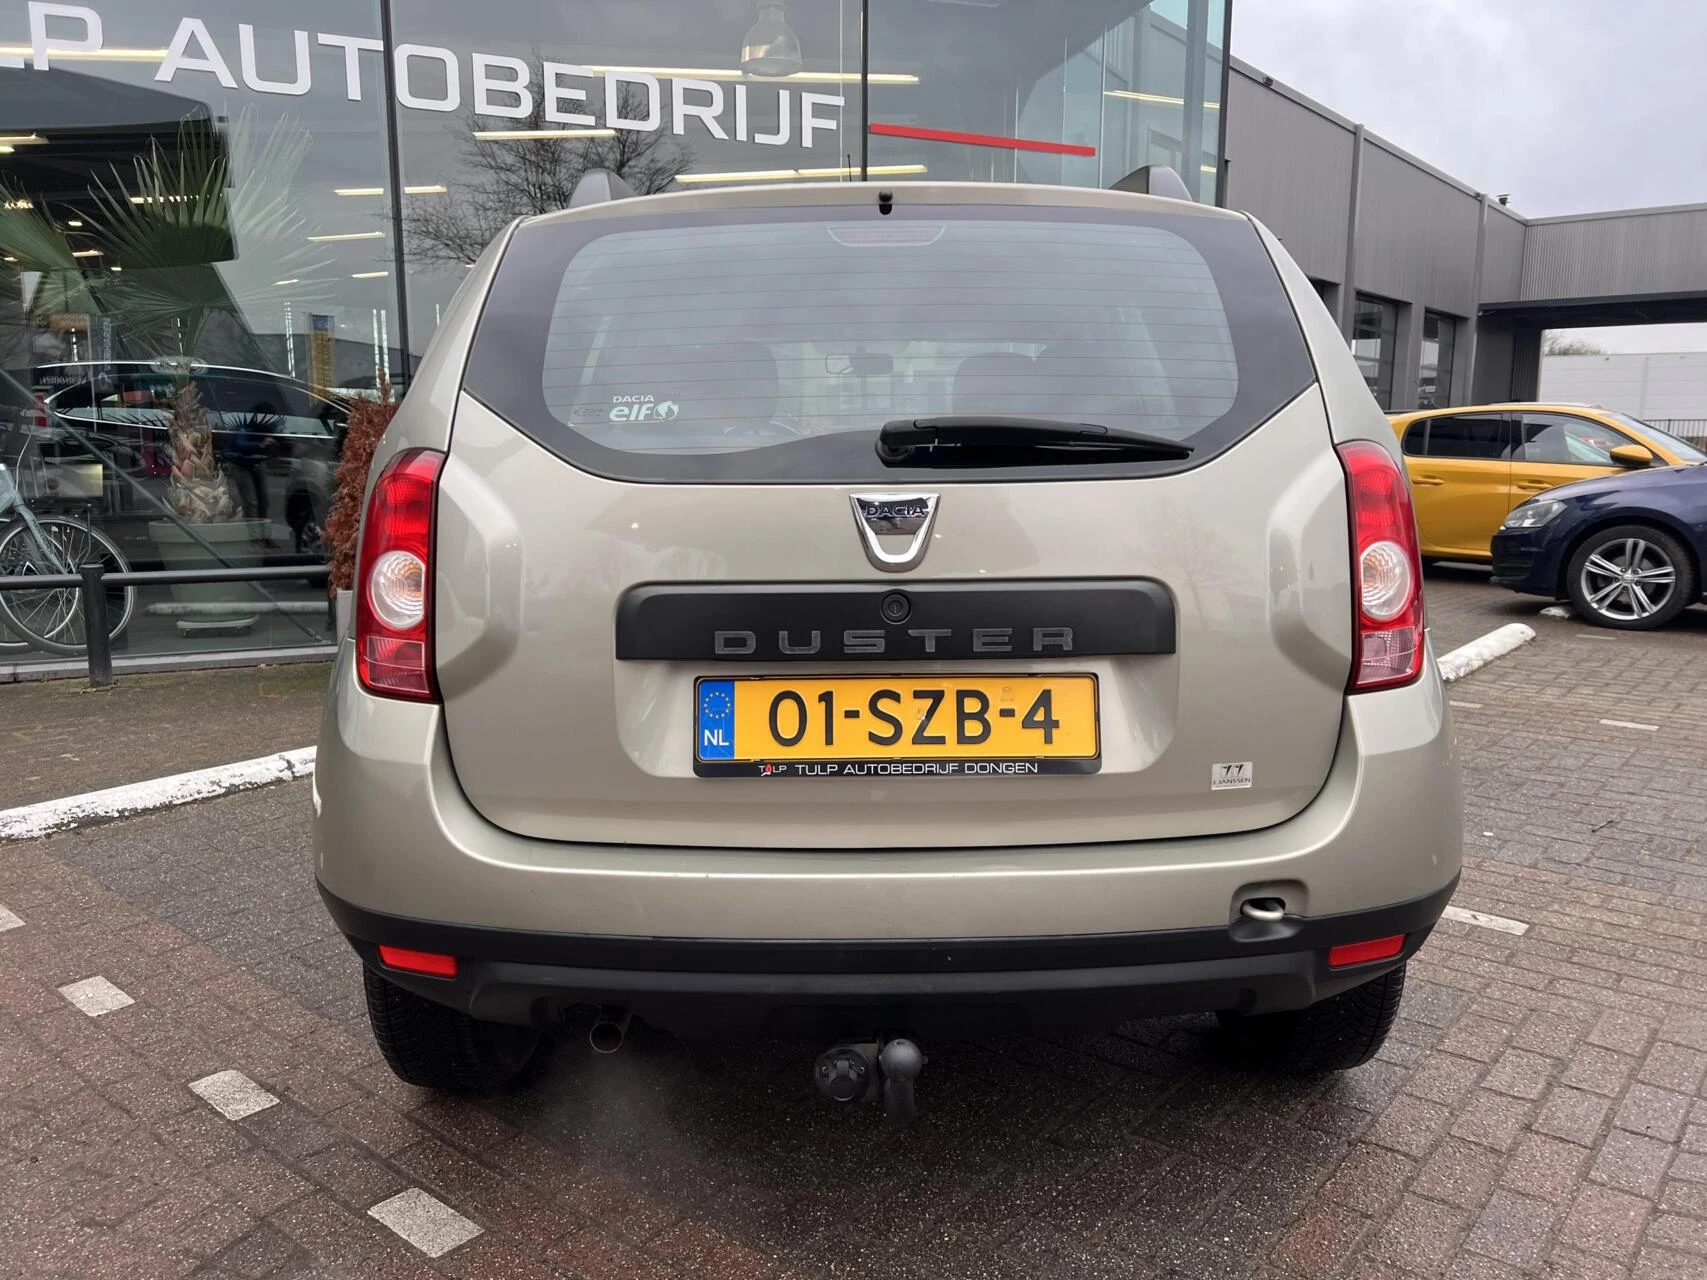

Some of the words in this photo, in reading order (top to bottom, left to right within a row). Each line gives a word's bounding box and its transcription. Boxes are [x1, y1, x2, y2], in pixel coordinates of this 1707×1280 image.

[154, 17, 846, 148] AUTOBEDRIJF
[612, 395, 655, 403] DACIA
[608, 403, 654, 421] elf
[866, 505, 926, 517] DACIA
[714, 627, 1074, 654] DUSTER
[768, 688, 1061, 747] 01-SZB-4
[703, 729, 729, 747] NL
[795, 764, 838, 775] TULP
[843, 763, 959, 775] AUTOBEDRIJF
[964, 762, 1038, 774] DONGEN
